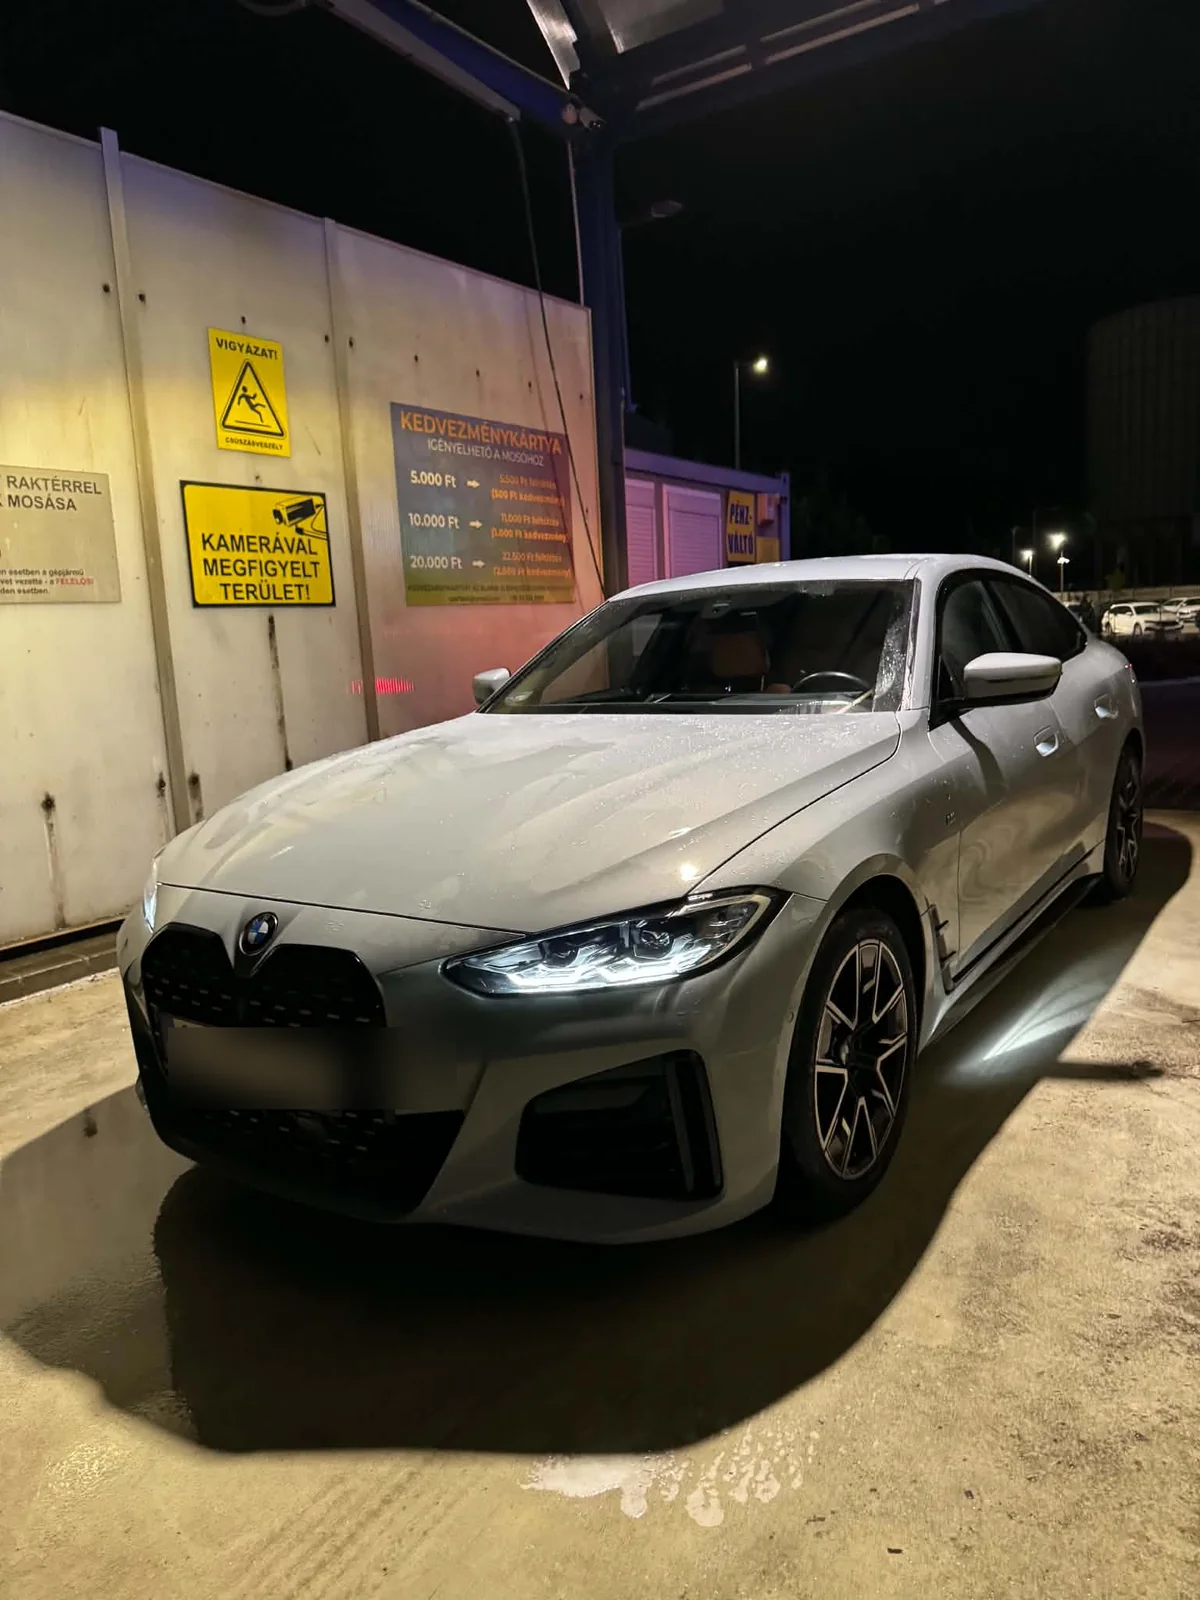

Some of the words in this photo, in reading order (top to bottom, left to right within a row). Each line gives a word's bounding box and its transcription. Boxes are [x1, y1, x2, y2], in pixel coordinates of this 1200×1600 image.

[216, 337, 278, 361] VIGYÁZAT!
[400, 410, 562, 455] KEDVEZMÉNYKÁRTYA
[225, 437, 283, 451] CSÚSZÁSVESZÉLY
[427, 438, 492, 459] IGÉNYELHETŐ
[494, 451, 502, 460] A
[503, 451, 545, 466] MOSÓHOZ
[7, 475, 102, 495] RAKTÉRREL
[410, 470, 442, 486] 5.000
[445, 475, 456, 488] Ft
[8, 492, 77, 511] MOSÁSA
[408, 513, 444, 528] 10.000
[448, 516, 459, 529] Ft
[730, 500, 752, 525] PÉNZ-
[202, 532, 318, 556] KAMERÁVAL
[728, 531, 753, 554] VÁLTÓ
[203, 559, 320, 579] MEGFIGYELT
[410, 556, 448, 569] 20.000
[451, 557, 462, 569] Ft
[220, 580, 311, 601] TERÜLET!
